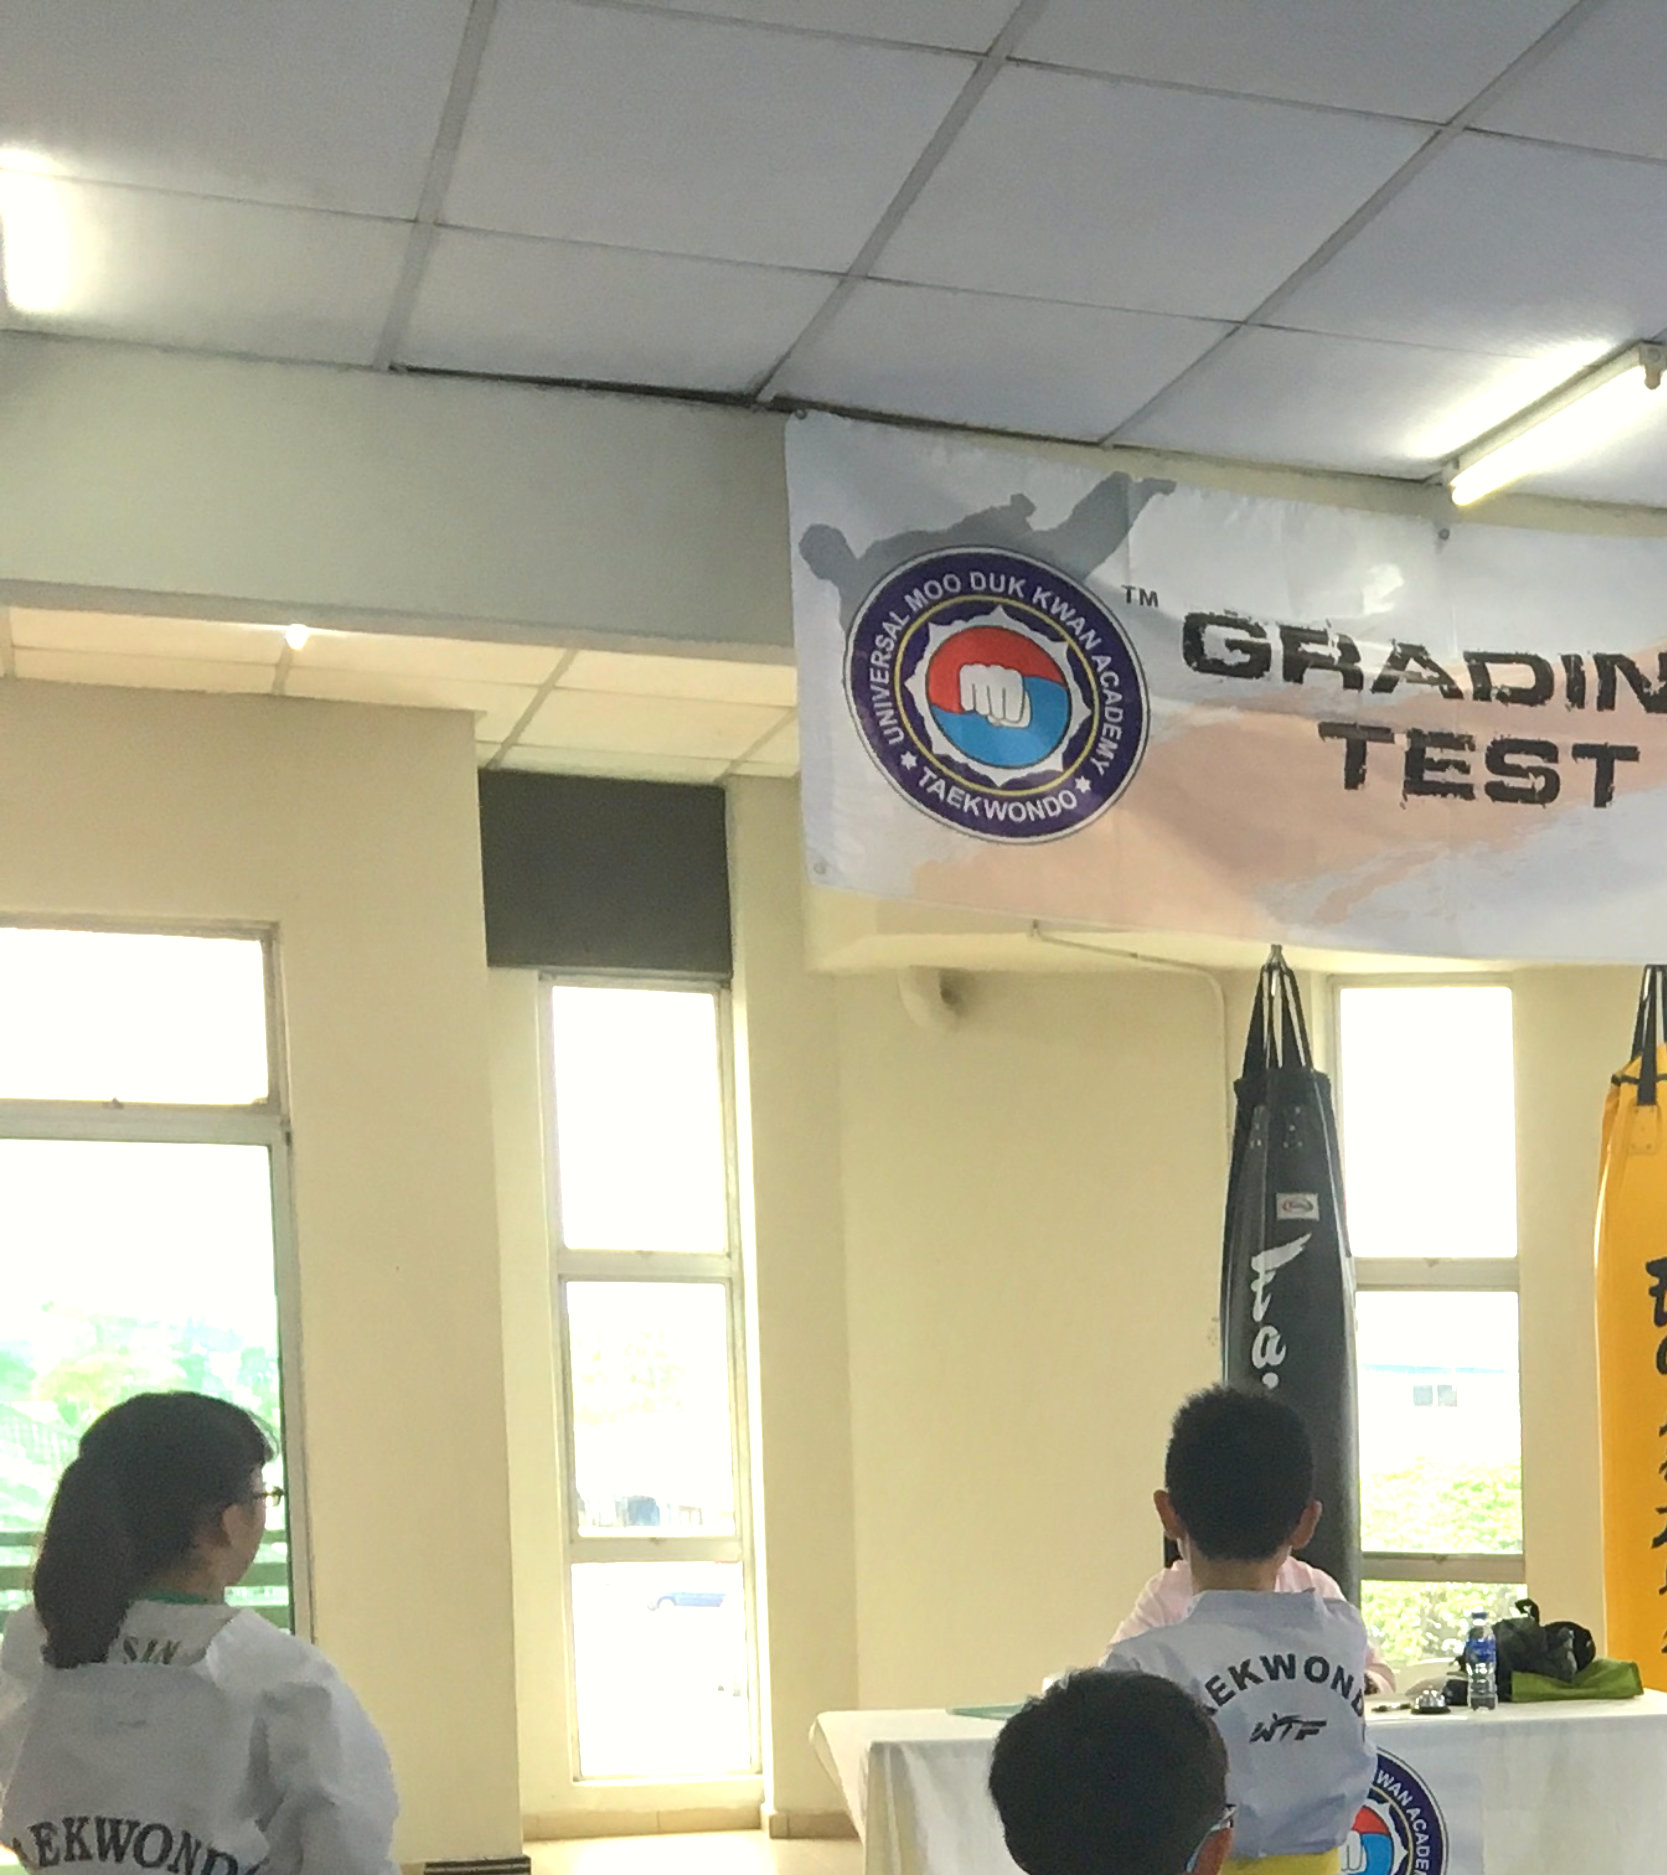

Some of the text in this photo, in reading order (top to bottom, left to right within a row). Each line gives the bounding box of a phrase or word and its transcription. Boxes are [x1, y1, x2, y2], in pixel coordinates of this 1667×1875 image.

[870, 571, 1124, 776] UNIVERSAL MOO DUK KWAN ACADEMY
[917, 766, 1077, 823] TAEKWONDO
[1316, 720, 1641, 808] TEST
[1377, 1769, 1414, 1806] WAN
